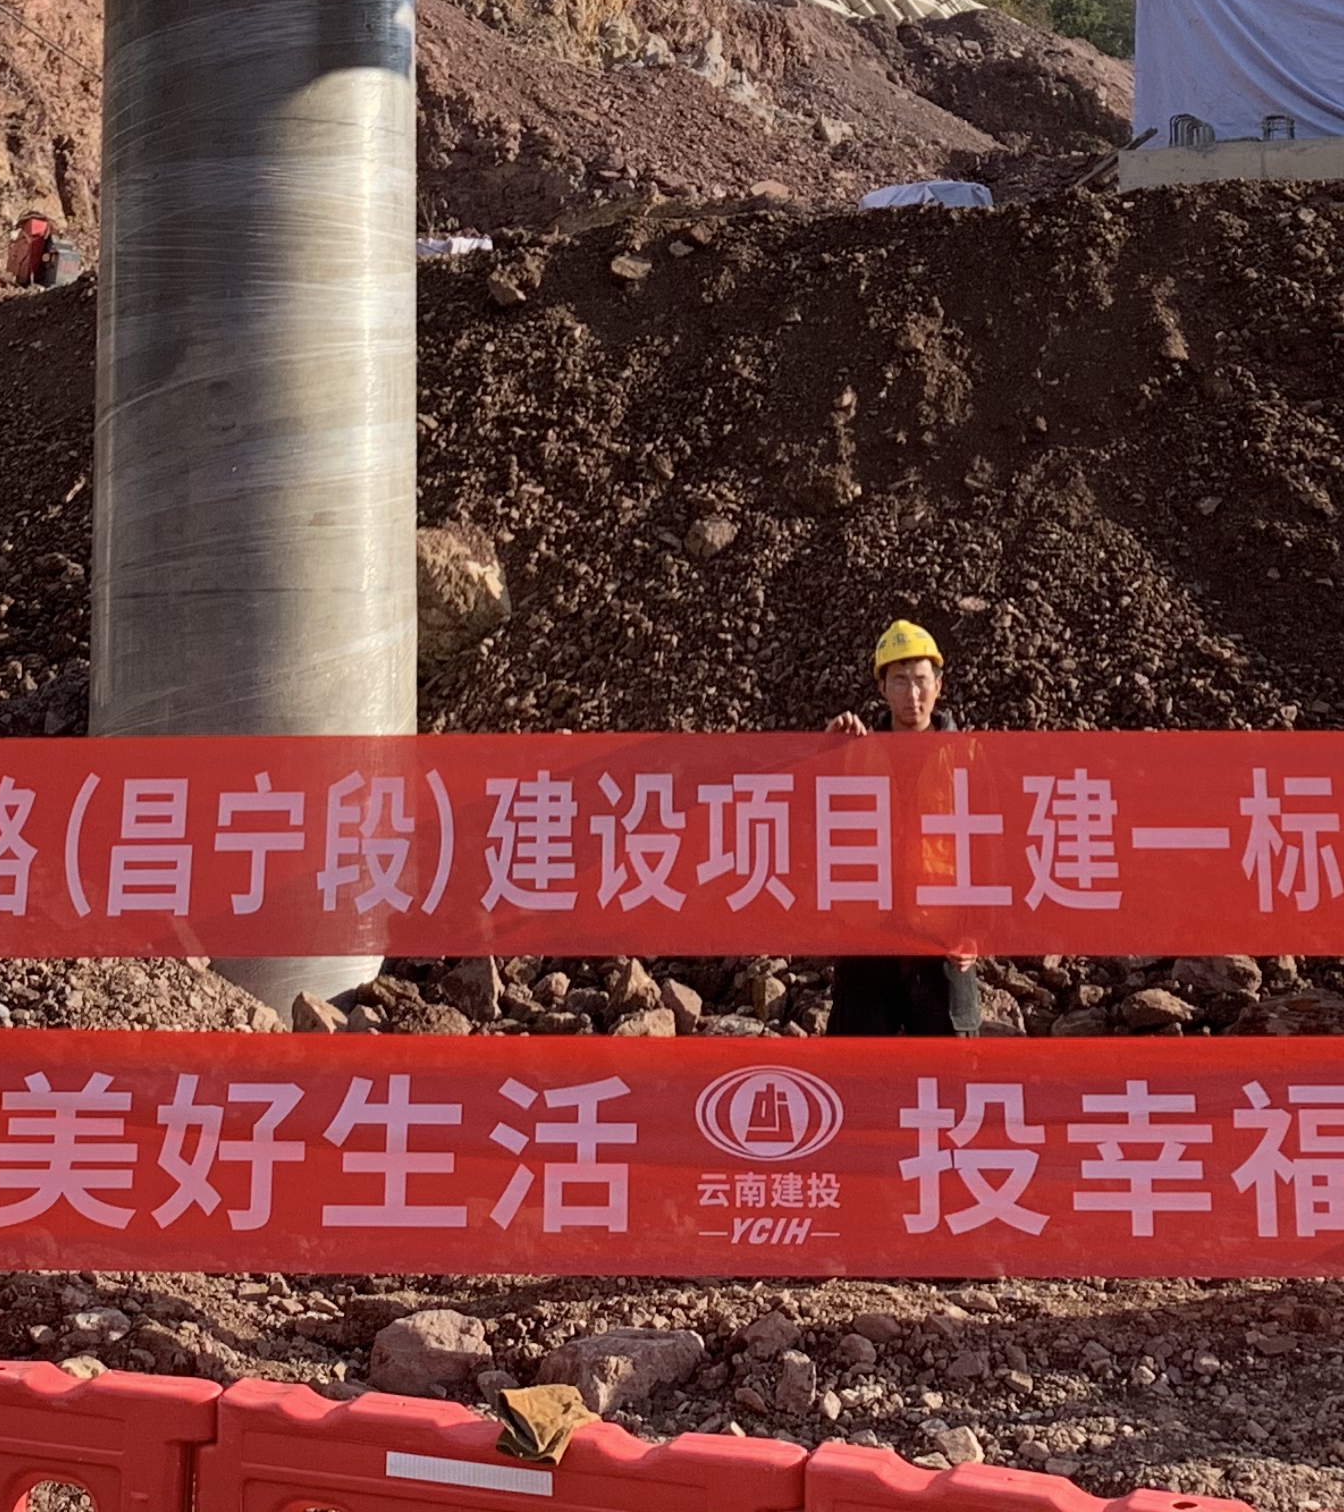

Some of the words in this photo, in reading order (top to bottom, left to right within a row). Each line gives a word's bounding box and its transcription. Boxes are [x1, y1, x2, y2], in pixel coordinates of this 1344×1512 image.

[697, 1172, 841, 1208] 云南建投
[731, 1218, 812, 1244] YCIH
